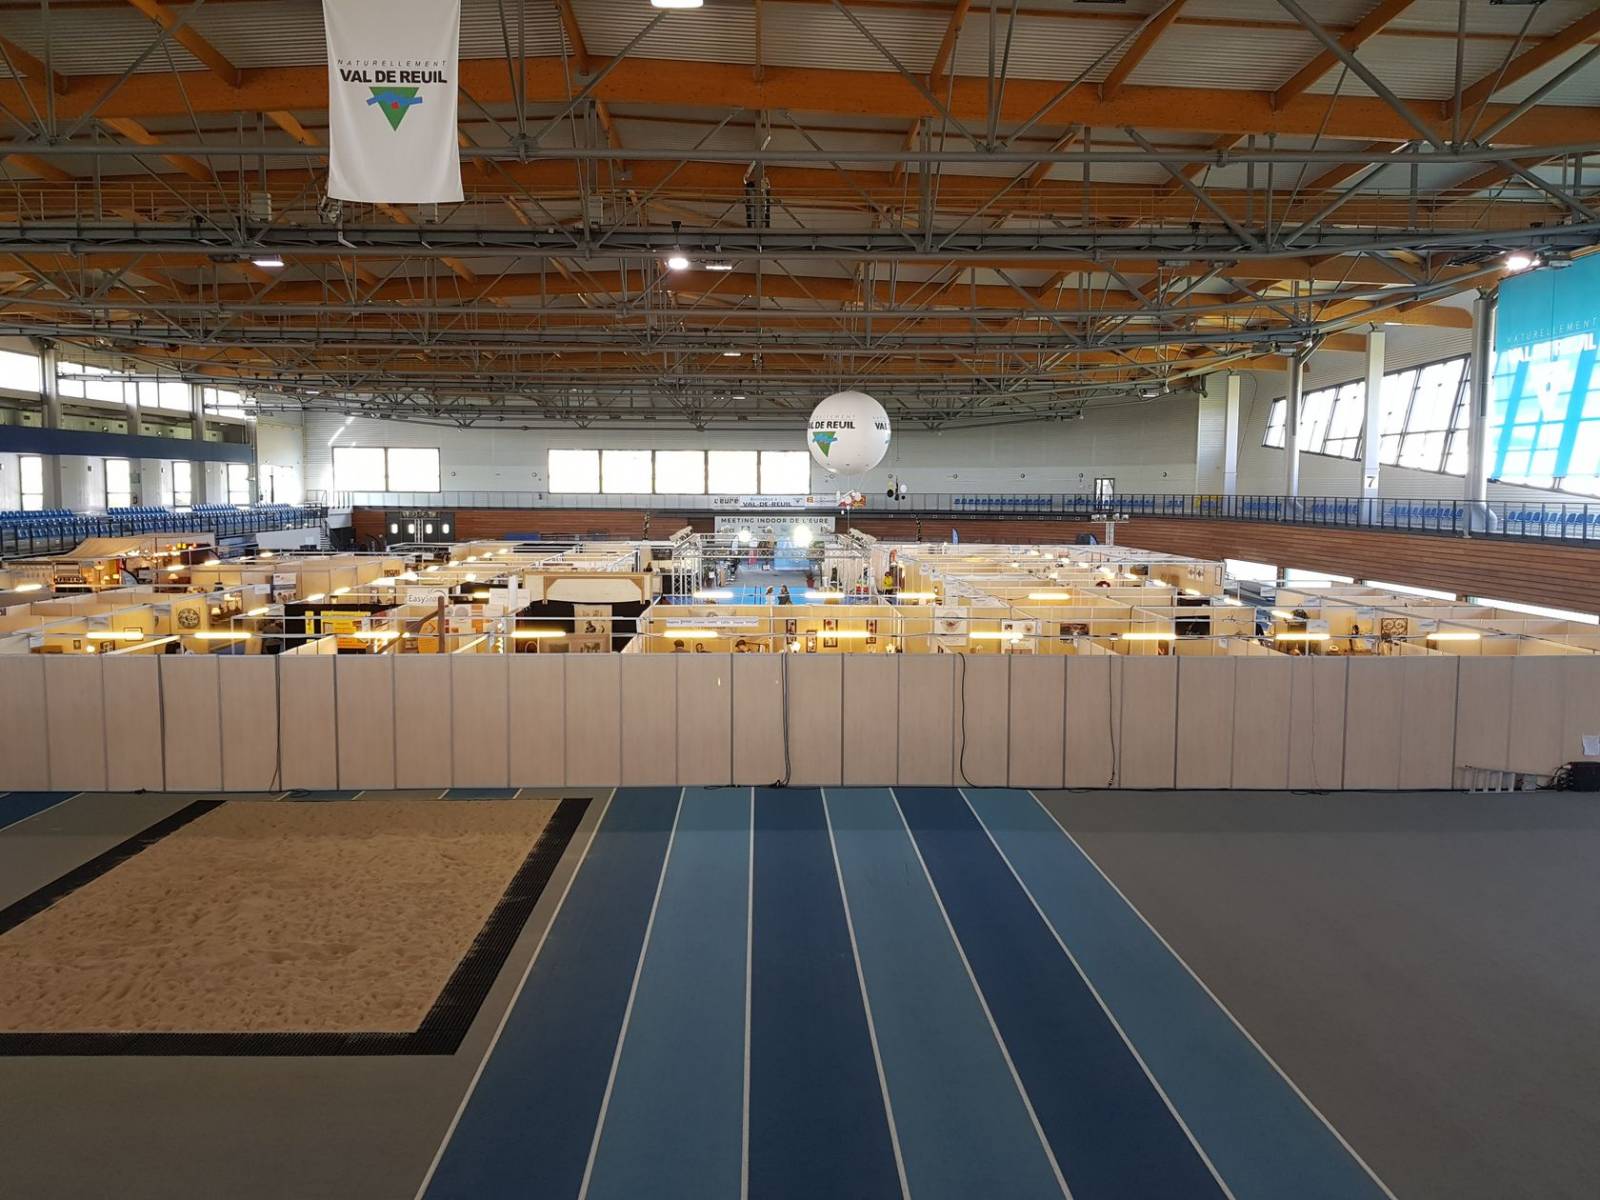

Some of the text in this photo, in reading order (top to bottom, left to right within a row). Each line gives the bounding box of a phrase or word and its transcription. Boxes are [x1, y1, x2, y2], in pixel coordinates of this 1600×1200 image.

[337, 59, 447, 67] NATURELLEMENT
[340, 68, 447, 84] VAL DE REUIL
[815, 421, 824, 429] DE
[827, 420, 855, 429] REUIL
